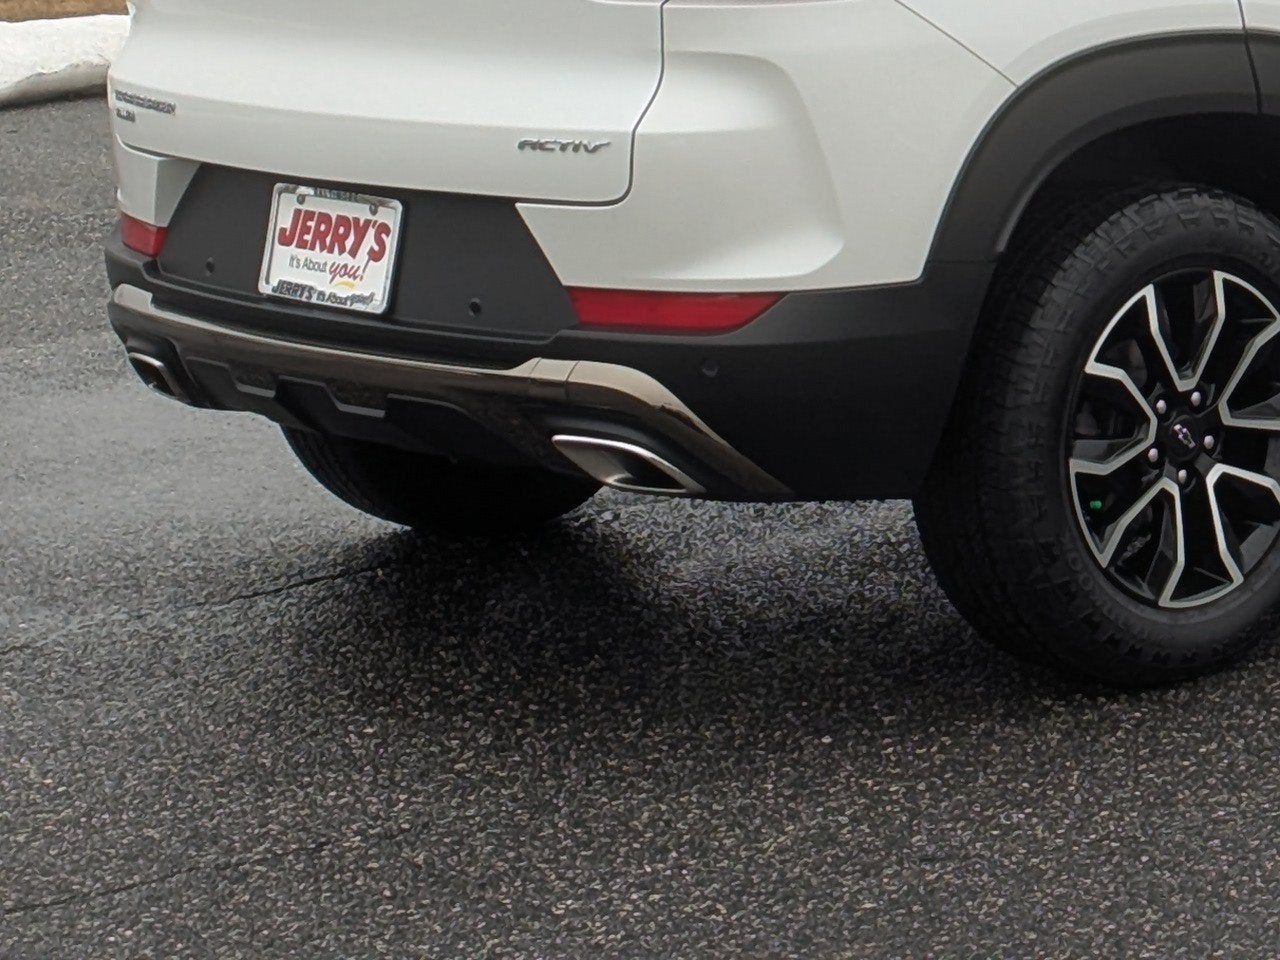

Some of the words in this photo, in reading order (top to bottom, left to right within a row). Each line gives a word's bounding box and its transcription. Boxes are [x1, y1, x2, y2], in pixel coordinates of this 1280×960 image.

[518, 139, 611, 154] ACTIV
[278, 208, 392, 263] JERRY'S
[289, 254, 301, 269] It's
[302, 257, 328, 273] About
[328, 257, 371, 285] you!
